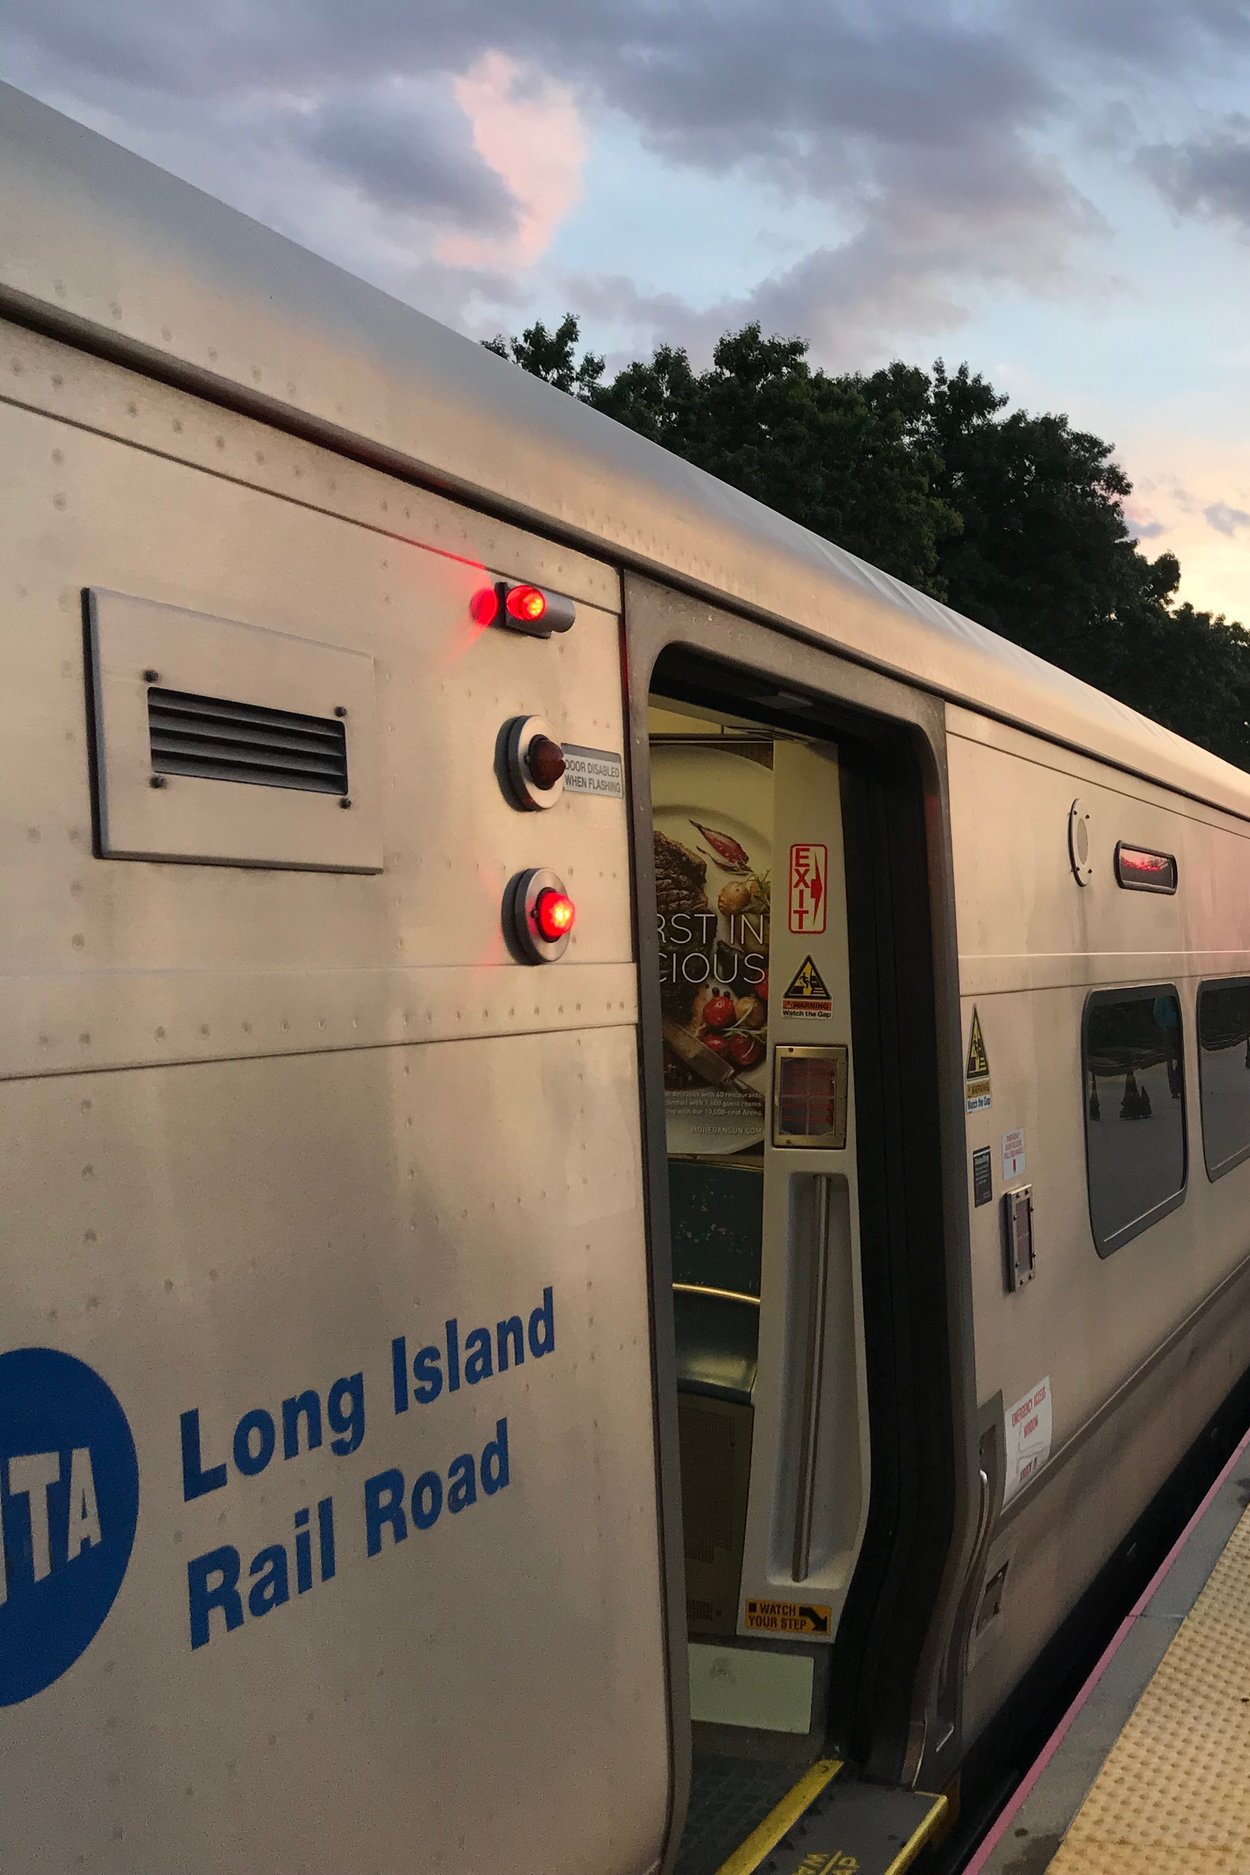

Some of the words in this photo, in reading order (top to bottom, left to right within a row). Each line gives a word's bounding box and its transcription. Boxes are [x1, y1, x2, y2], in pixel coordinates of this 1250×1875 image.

[565, 759, 586, 773] DOOR
[587, 763, 620, 778] DISABLED
[565, 773, 587, 789] WHEN
[588, 778, 621, 793] FLASHING
[793, 847, 811, 930] EXIT
[730, 914, 764, 945] IN
[817, 1011, 832, 1019] Gap
[179, 1370, 365, 1502] Long
[391, 1285, 556, 1415] Island
[0, 1446, 101, 1606] TA
[187, 1496, 336, 1651] Rail
[364, 1417, 510, 1558] Road
[760, 1602, 796, 1617] WATCH
[749, 1615, 777, 1629] YOUR
[781, 1618, 806, 1630] STEP
